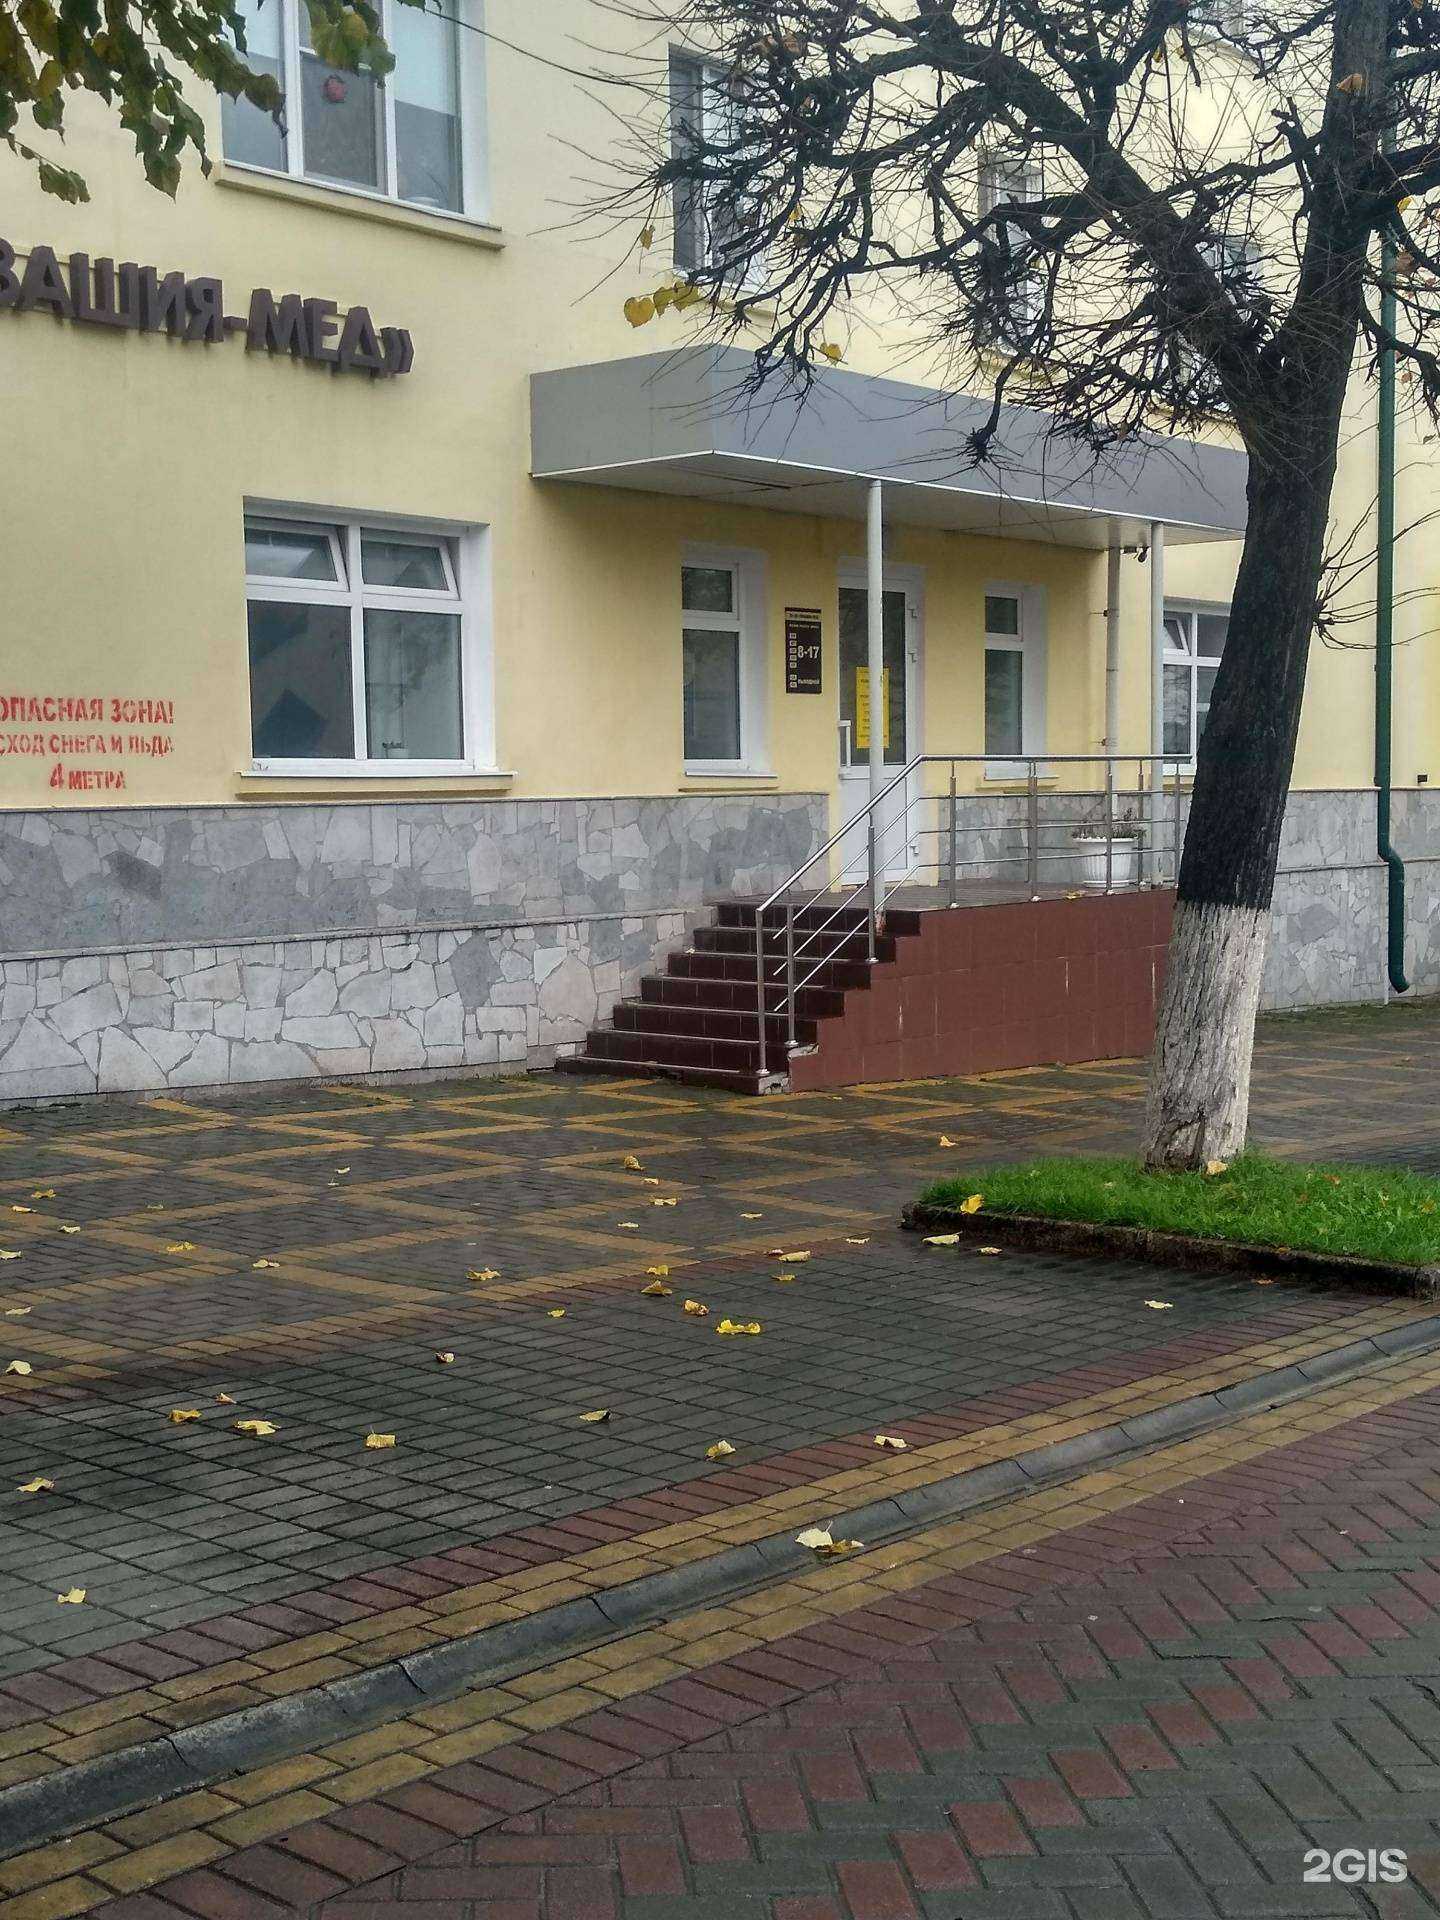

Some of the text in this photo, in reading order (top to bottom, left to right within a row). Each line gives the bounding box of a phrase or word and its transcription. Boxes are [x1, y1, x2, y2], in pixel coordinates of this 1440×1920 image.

[797, 645, 820, 659] 8-17
[0, 697, 174, 724] ОПАСНАЯ ЗОНА!
[49, 734, 106, 754] СНЕГА
[111, 735, 123, 754] И
[50, 763, 126, 789] 4 МЕТРА
